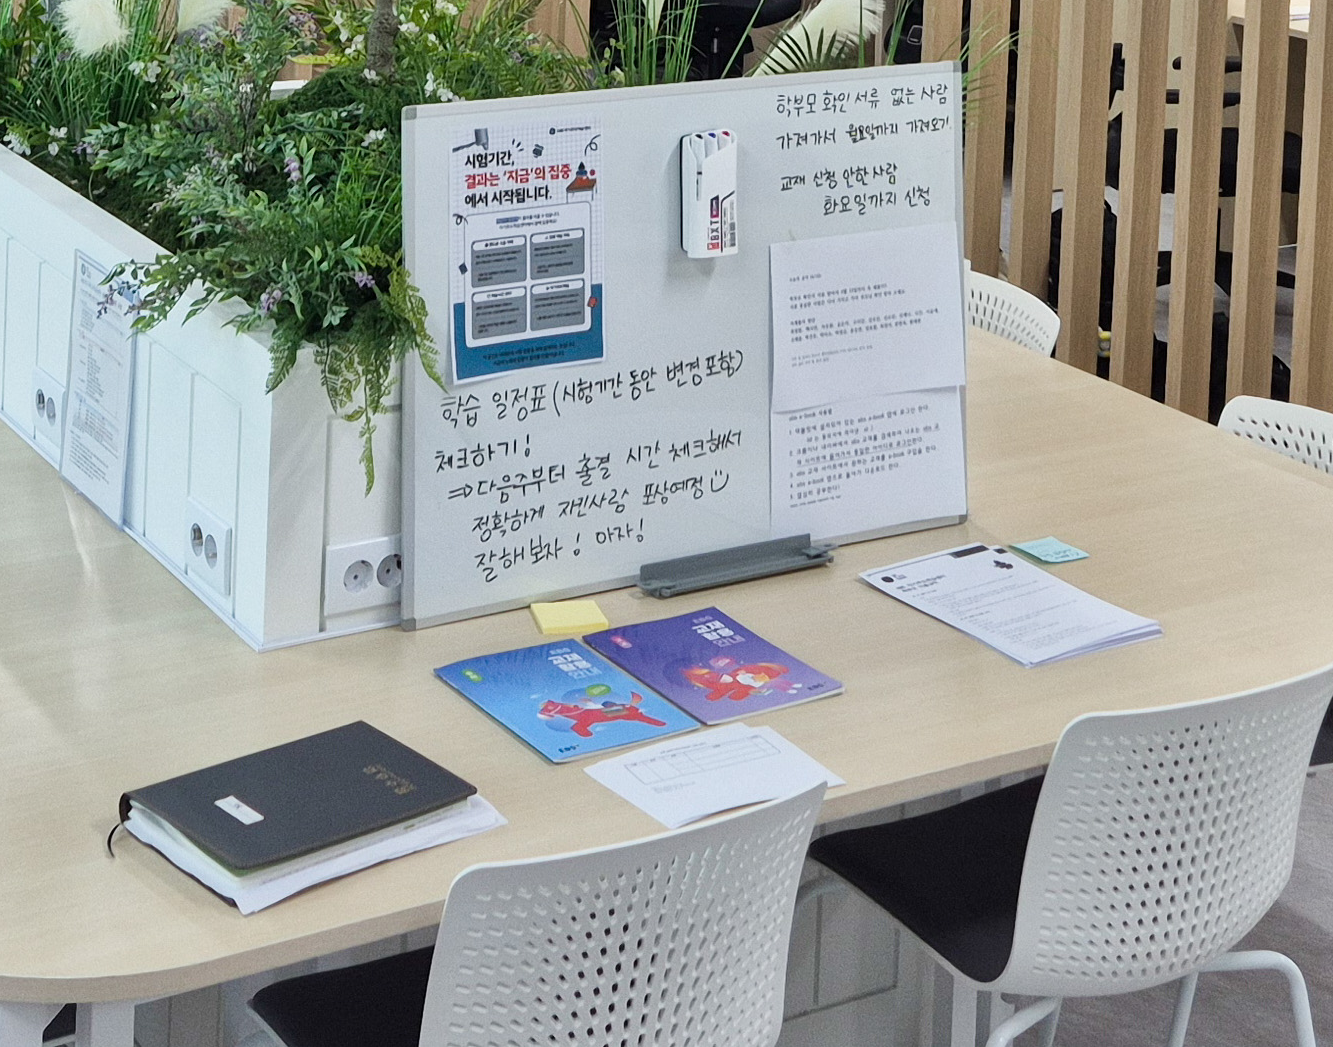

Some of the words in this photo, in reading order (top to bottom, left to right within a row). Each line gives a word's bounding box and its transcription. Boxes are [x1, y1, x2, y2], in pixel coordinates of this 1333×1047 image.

[776, 93, 817, 118] 학부모
[822, 90, 850, 114] 확인
[854, 87, 881, 109] 서류
[890, 87, 916, 107] 없는
[920, 83, 949, 105] 사람
[775, 128, 837, 150] 가져가서
[844, 122, 899, 144] 월요일까지
[464, 150, 516, 169] 시험기간,
[464, 172, 501, 190] 결과는
[547, 163, 572, 180] 집중
[779, 174, 806, 191] 교재
[812, 166, 838, 189] 신청
[464, 192, 489, 209] 에서
[491, 183, 553, 206] 시작됩니다.
[823, 190, 897, 216] 화요일까지
[904, 185, 931, 207] 신청
[440, 393, 482, 430] 학습
[629, 365, 657, 401] 동안
[434, 433, 531, 473] 체크하기!
[477, 464, 565, 504] 다음주부터
[575, 452, 612, 487] 출결
[625, 439, 661, 470] 시간
[667, 428, 742, 463] 체크해서
[471, 504, 545, 543] 정확하게
[642, 475, 704, 505] 포상예정
[595, 517, 645, 544] 아자!
[691, 619, 726, 635] 교재
[712, 634, 746, 648] 안내
[547, 652, 584, 666] 교재
[568, 666, 603, 680] 안내
